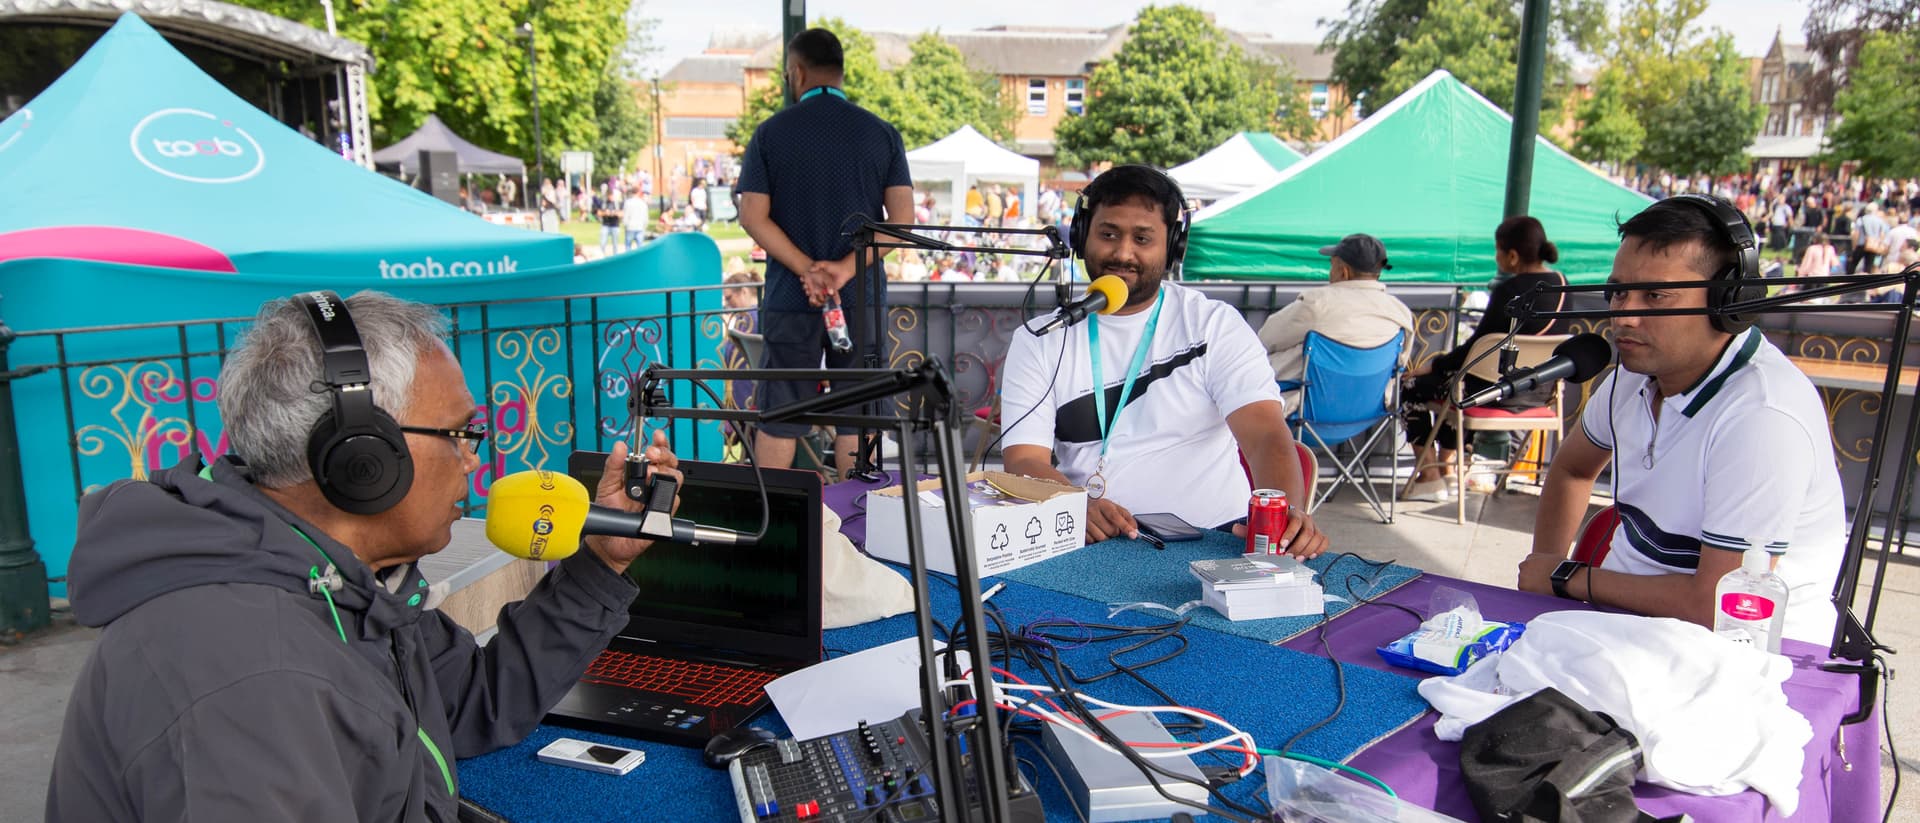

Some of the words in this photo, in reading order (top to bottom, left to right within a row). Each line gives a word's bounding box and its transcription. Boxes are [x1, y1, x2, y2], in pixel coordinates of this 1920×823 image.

[152, 135, 243, 158] toob
[378, 254, 518, 279] toob.couk
[138, 372, 218, 404] too
